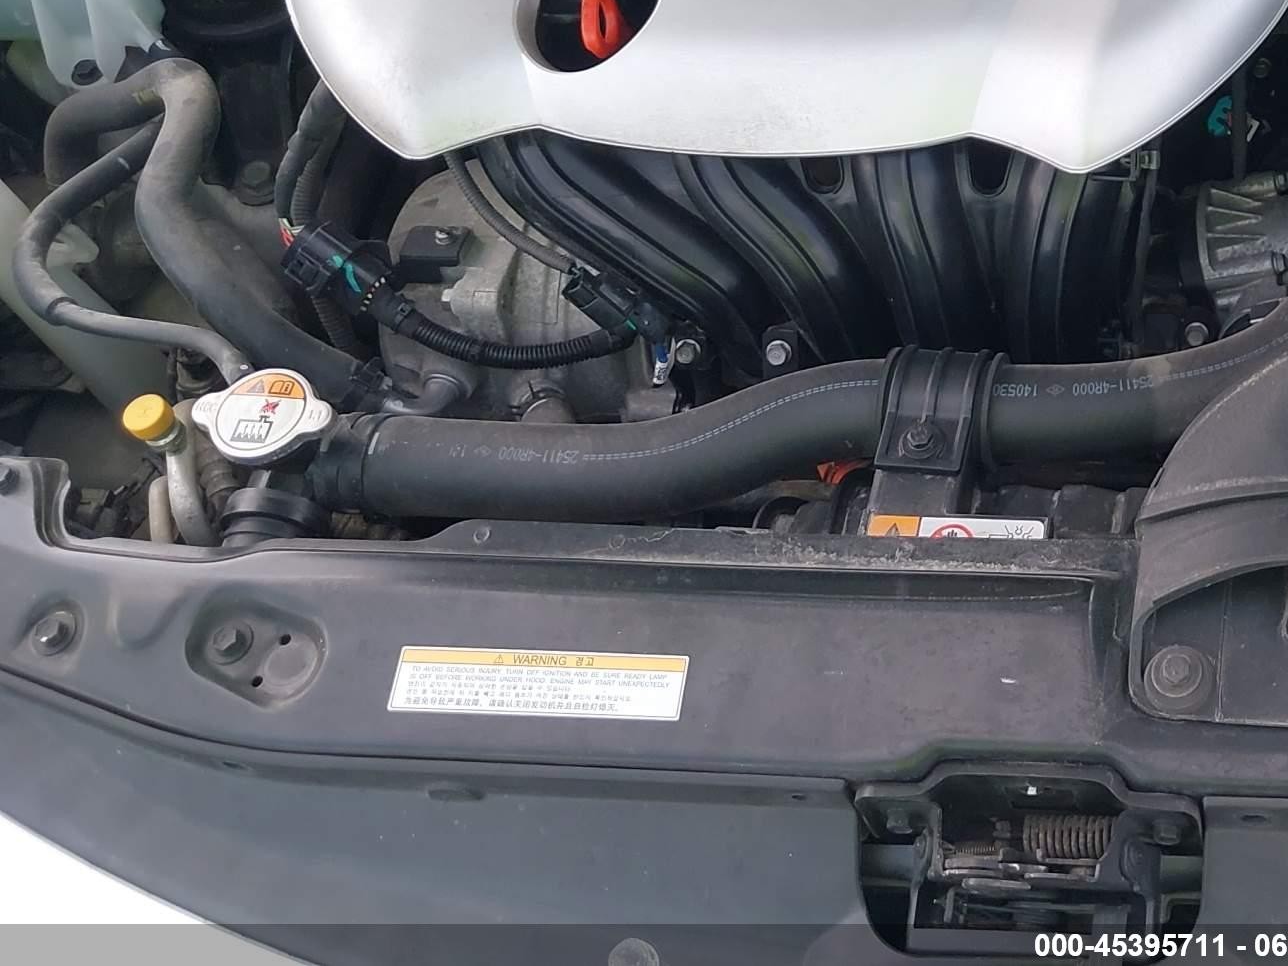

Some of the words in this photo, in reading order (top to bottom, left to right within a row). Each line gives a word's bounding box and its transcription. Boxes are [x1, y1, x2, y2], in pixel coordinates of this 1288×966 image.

[1072, 375, 1153, 397] 25411-4R000
[513, 654, 567, 667] WARNING
[575, 655, 595, 667] 경고
